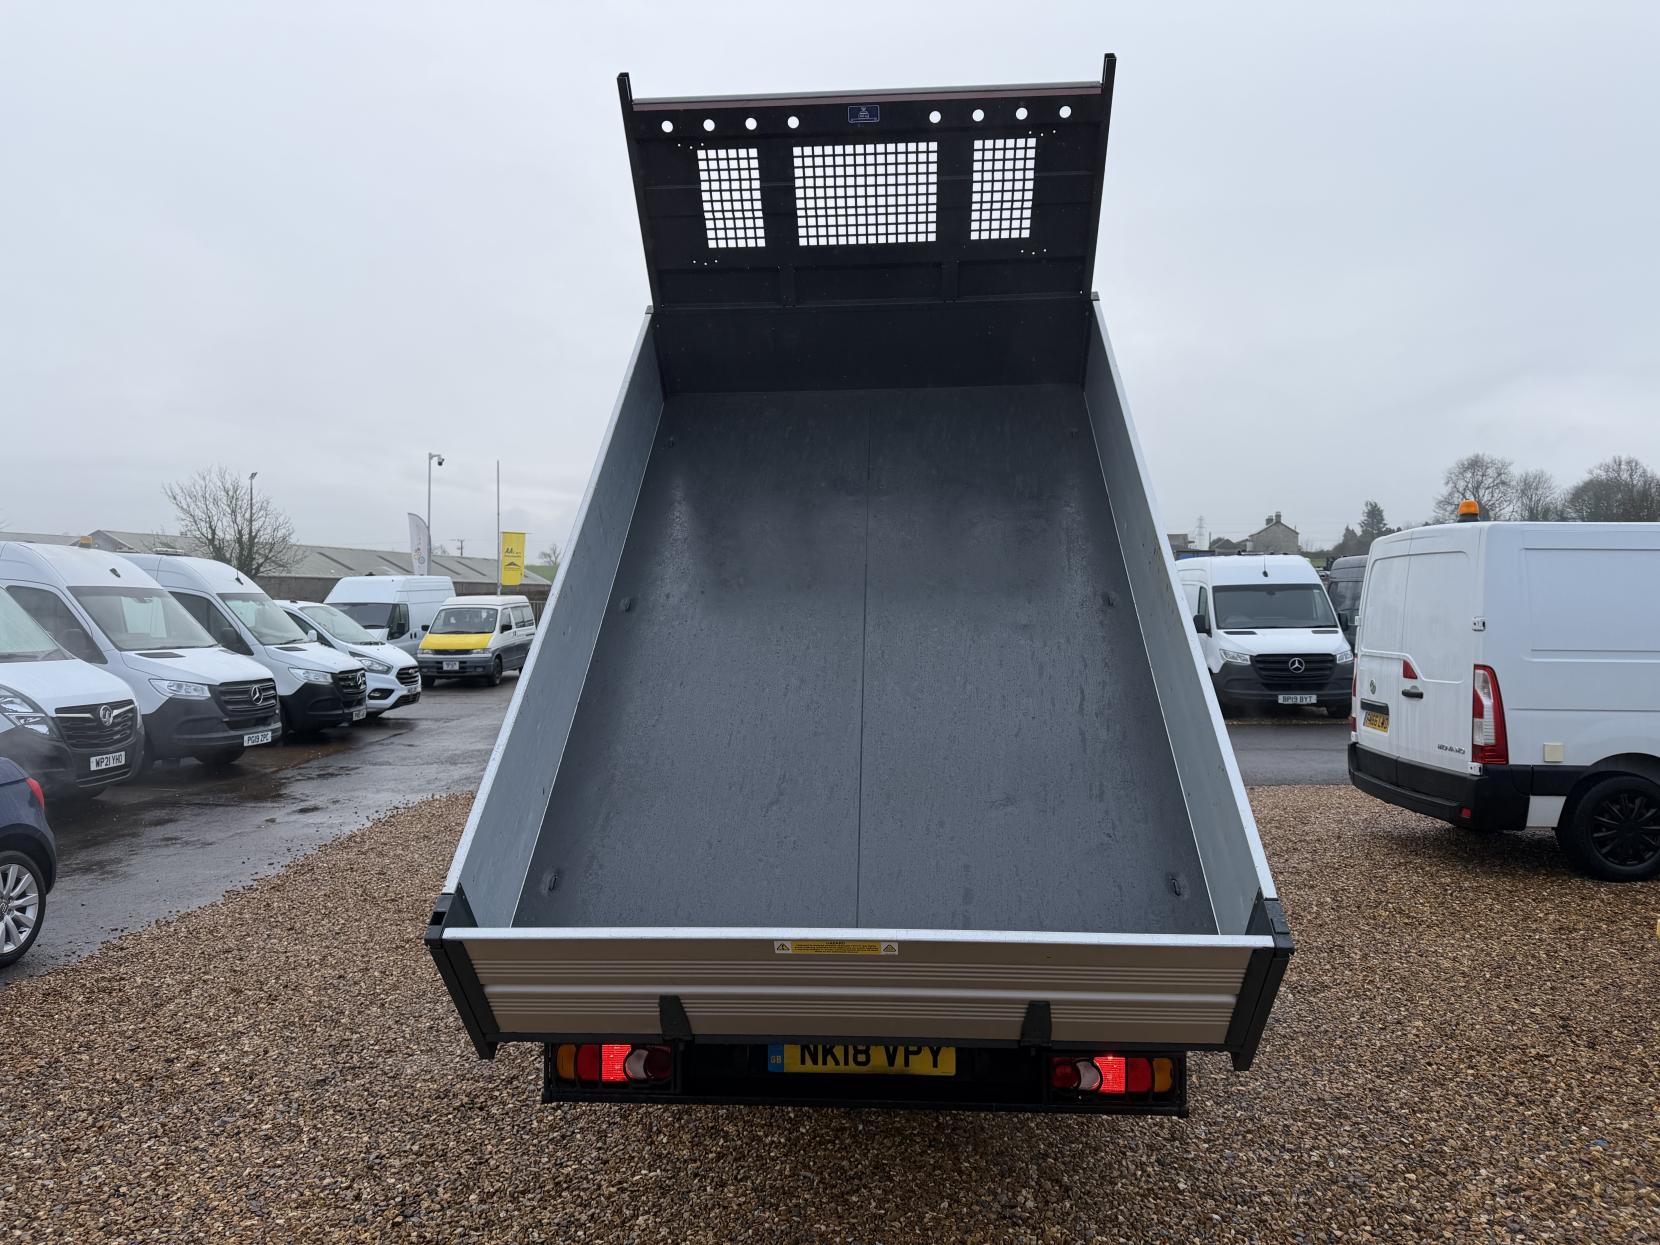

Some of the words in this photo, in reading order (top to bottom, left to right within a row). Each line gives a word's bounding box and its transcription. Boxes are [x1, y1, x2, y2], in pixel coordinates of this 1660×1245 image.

[95, 755, 111, 768] WP21
[770, 1055, 782, 1064] GB
[800, 1044, 871, 1067] NK18
[883, 1045, 942, 1068] VPY
